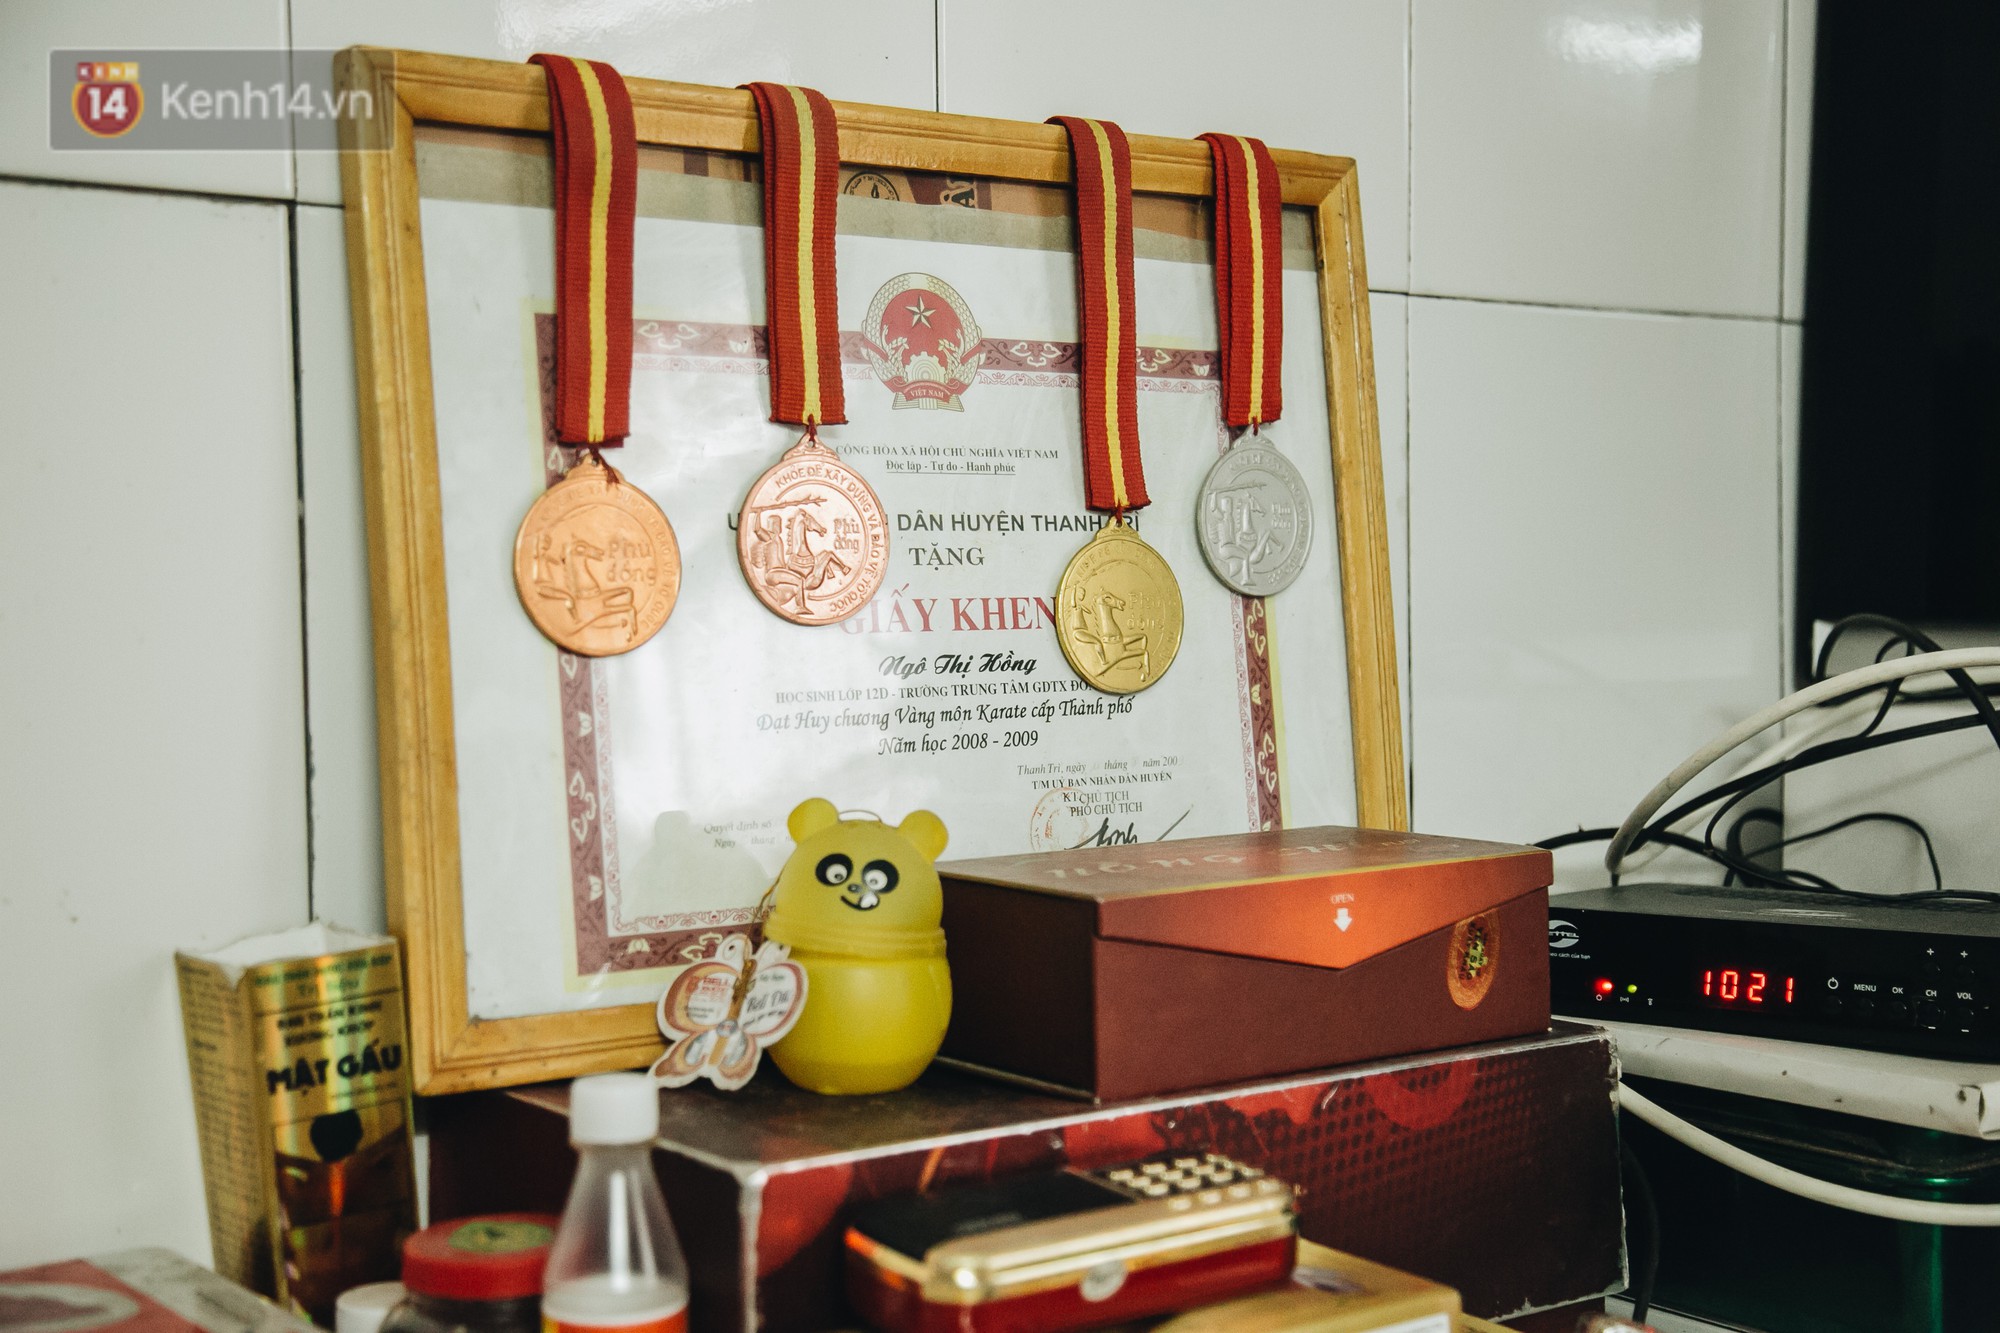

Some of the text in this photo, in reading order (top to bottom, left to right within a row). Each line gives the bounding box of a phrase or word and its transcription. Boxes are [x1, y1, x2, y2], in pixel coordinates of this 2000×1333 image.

[927, 389, 944, 399] NAM
[919, 445, 940, 457] HỘI
[1034, 449, 1059, 459] NAM
[886, 460, 904, 472] Độc
[907, 460, 922, 473] lập
[946, 461, 958, 472] do
[966, 461, 991, 474] Hạnh
[994, 462, 1016, 475] phúc
[898, 511, 943, 532] DÂN
[951, 512, 1025, 536] HUYỆN
[1031, 515, 1101, 532] THANH
[909, 545, 985, 571] TẶNG
[950, 597, 1057, 632] KHEN
[879, 650, 1037, 680] Ngô Thị Hồng
[806, 690, 835, 703] SINH
[866, 687, 889, 700] 12D
[899, 683, 948, 699] TRƯỜNG
[951, 683, 997, 697] TRUNG
[1000, 679, 1030, 694] TÂM
[1032, 680, 1067, 693] GDTX
[794, 710, 830, 735] Huy
[834, 708, 890, 731] chương
[894, 705, 936, 728] Vàng
[940, 705, 973, 722] môn
[976, 703, 1027, 724] Karate
[1031, 699, 1055, 723] cấp
[1059, 697, 1103, 717] Thành
[1107, 695, 1136, 720] phố
[878, 737, 917, 755] Năm
[921, 733, 947, 755] học
[952, 732, 988, 751] 2008
[1003, 730, 1039, 748] 2009
[1017, 763, 1046, 776] Thanh
[1066, 761, 1087, 775] ngày
[1104, 759, 1128, 772] tháng
[1068, 777, 1087, 788] BAN
[1104, 790, 1130, 804] TỊCH
[1119, 801, 1143, 816] TỊCH
[1703, 970, 1794, 1004] 1021
[1853, 983, 1877, 993] MENU
[1891, 986, 1904, 995] OK
[1925, 989, 1937, 998] CH
[1956, 992, 1973, 1001] VOL
[266, 1058, 329, 1096] MẬT
[337, 1038, 402, 1078] GẤU
